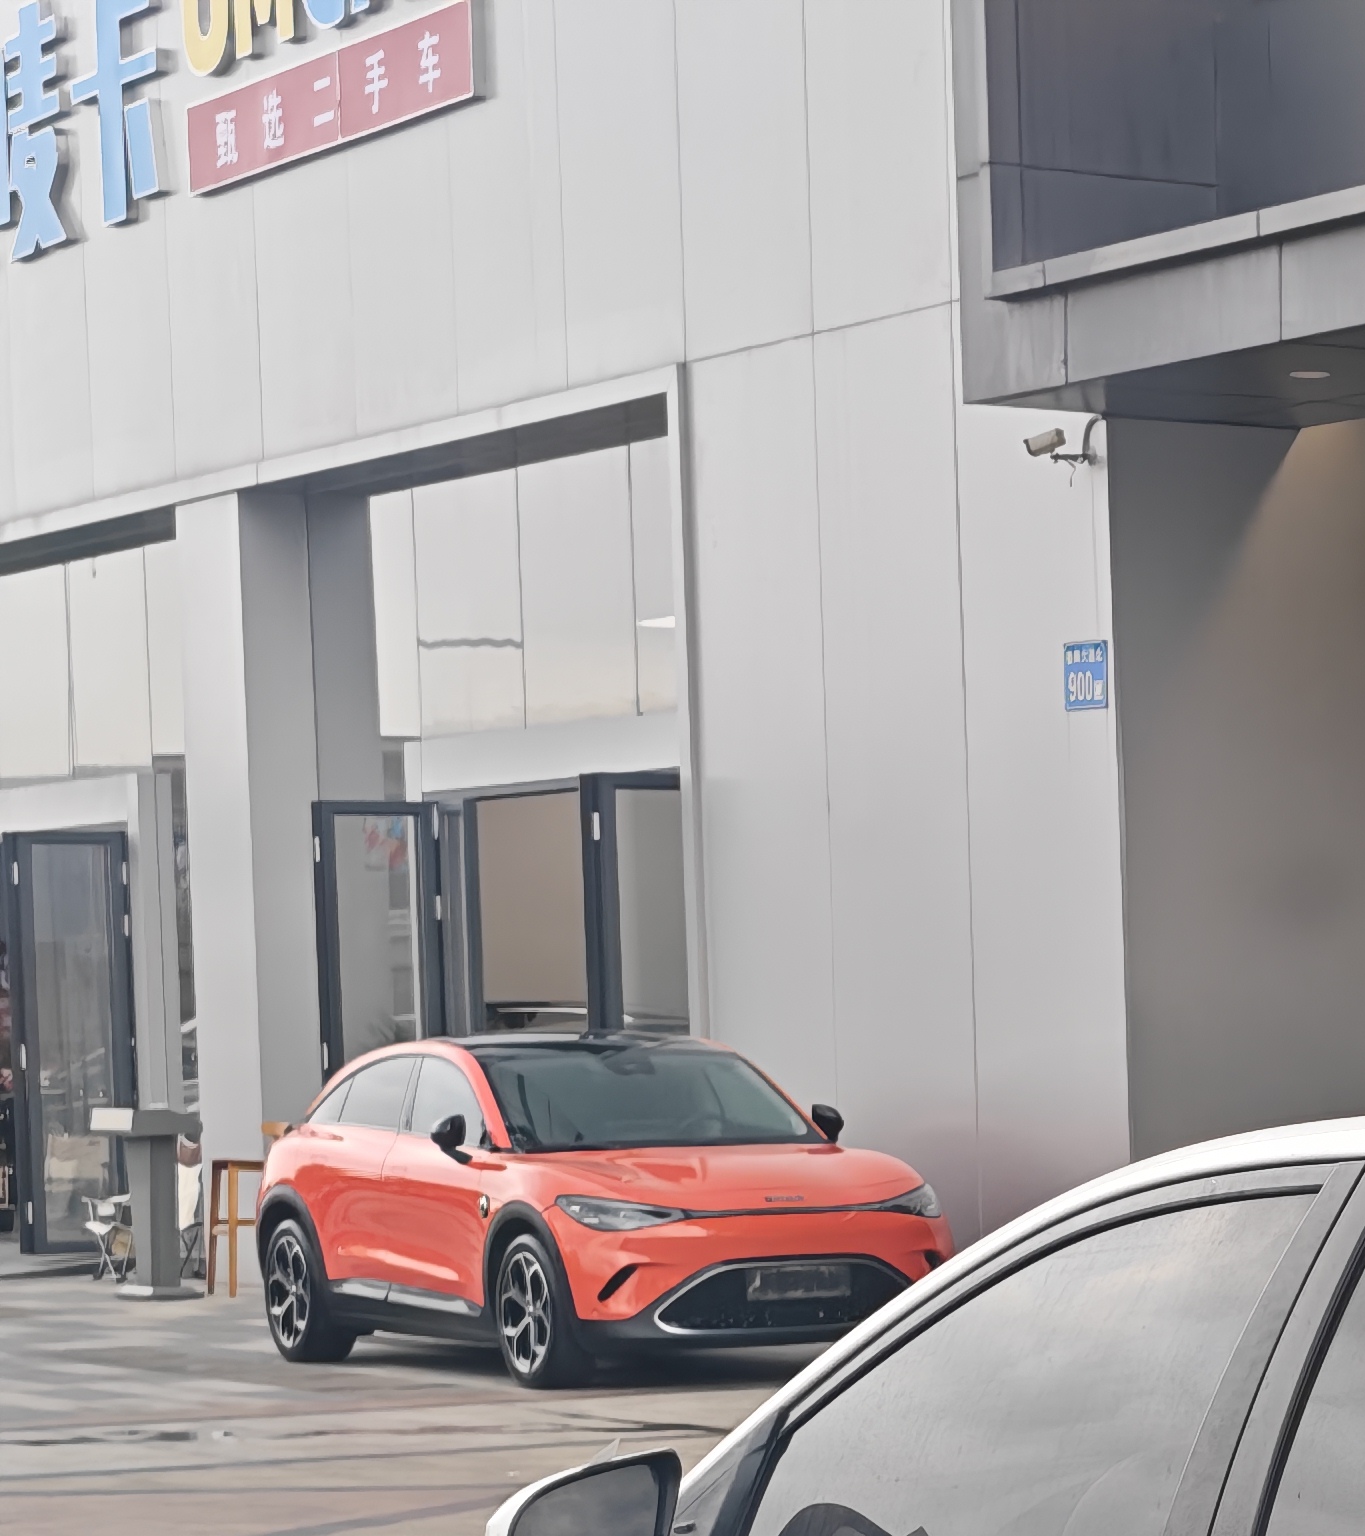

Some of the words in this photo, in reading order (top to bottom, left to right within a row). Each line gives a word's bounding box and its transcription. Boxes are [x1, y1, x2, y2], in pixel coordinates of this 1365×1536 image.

[215, 30, 442, 169] 甄选二手车
